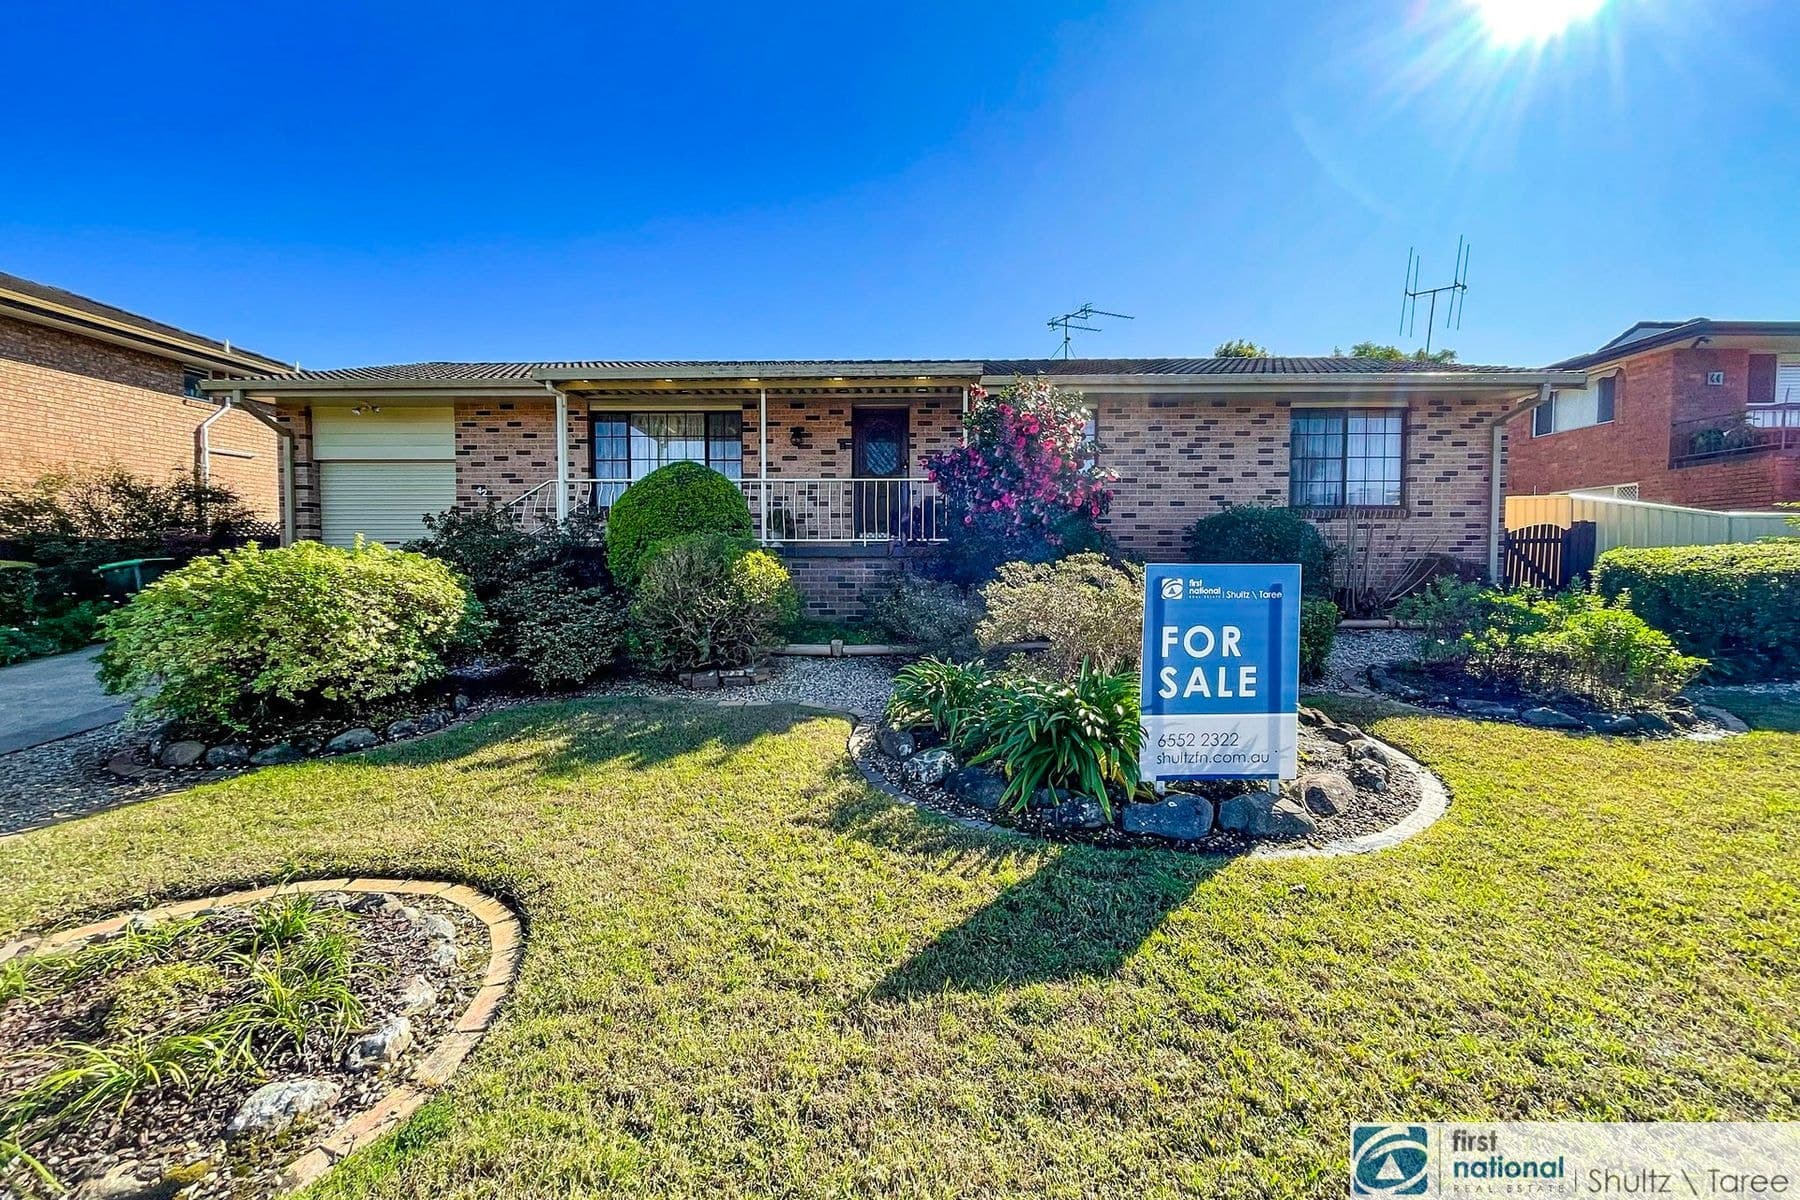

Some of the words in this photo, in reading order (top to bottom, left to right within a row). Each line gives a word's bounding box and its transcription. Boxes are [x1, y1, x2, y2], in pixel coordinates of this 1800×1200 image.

[476, 486, 488, 497] 42
[1188, 586, 1221, 595] national
[1226, 590, 1250, 599] Shultz
[1259, 590, 1283, 599] Taree
[1161, 625, 1242, 658] FOR
[1158, 666, 1257, 699] SALE
[1157, 732, 1196, 748] 6552
[1200, 732, 1239, 747] 2322
[1156, 750, 1270, 765] shultzfn.com.au
